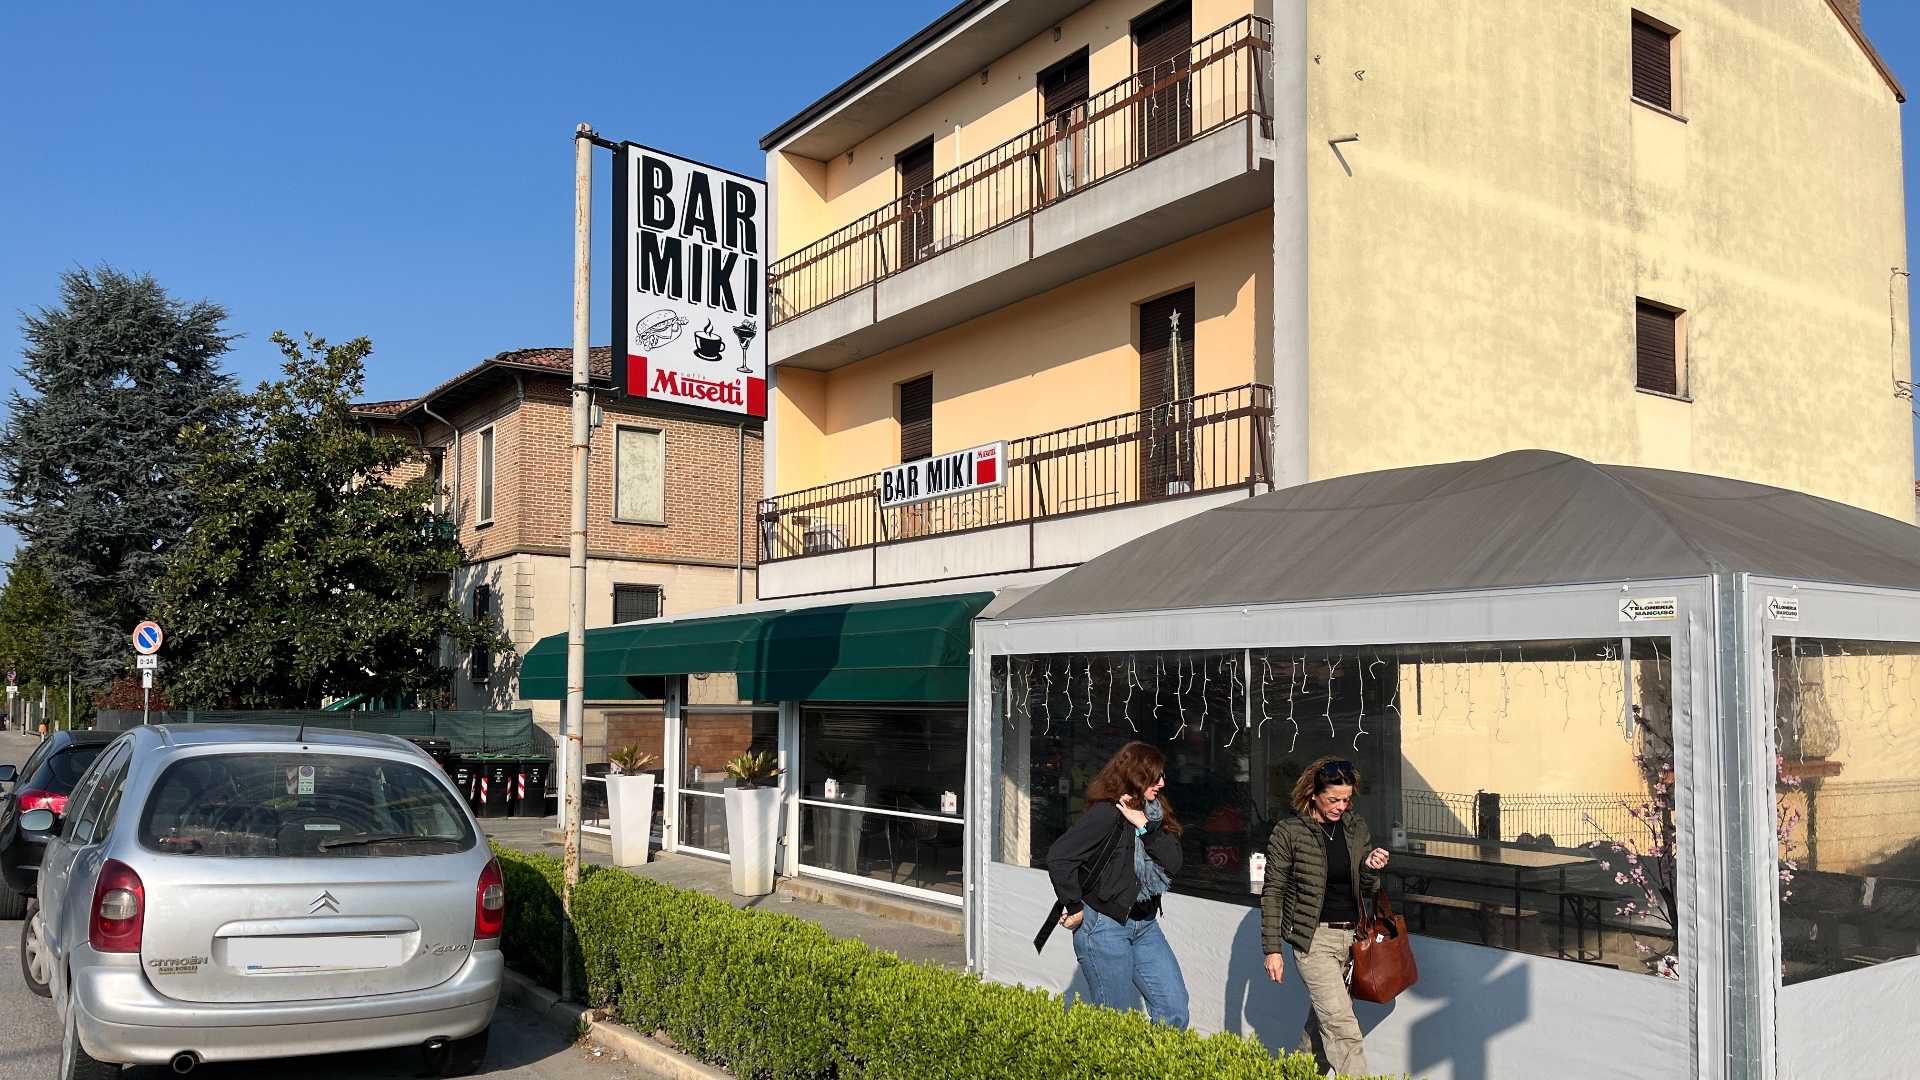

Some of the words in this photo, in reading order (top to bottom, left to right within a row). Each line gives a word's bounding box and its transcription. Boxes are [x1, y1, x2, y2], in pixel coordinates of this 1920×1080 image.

[637, 154, 758, 257] BAR
[636, 230, 758, 318] MIKI
[650, 368, 744, 406] Musetti
[883, 465, 919, 505] BAR
[926, 451, 973, 495] MIKI
[149, 955, 208, 967] CITROËN
